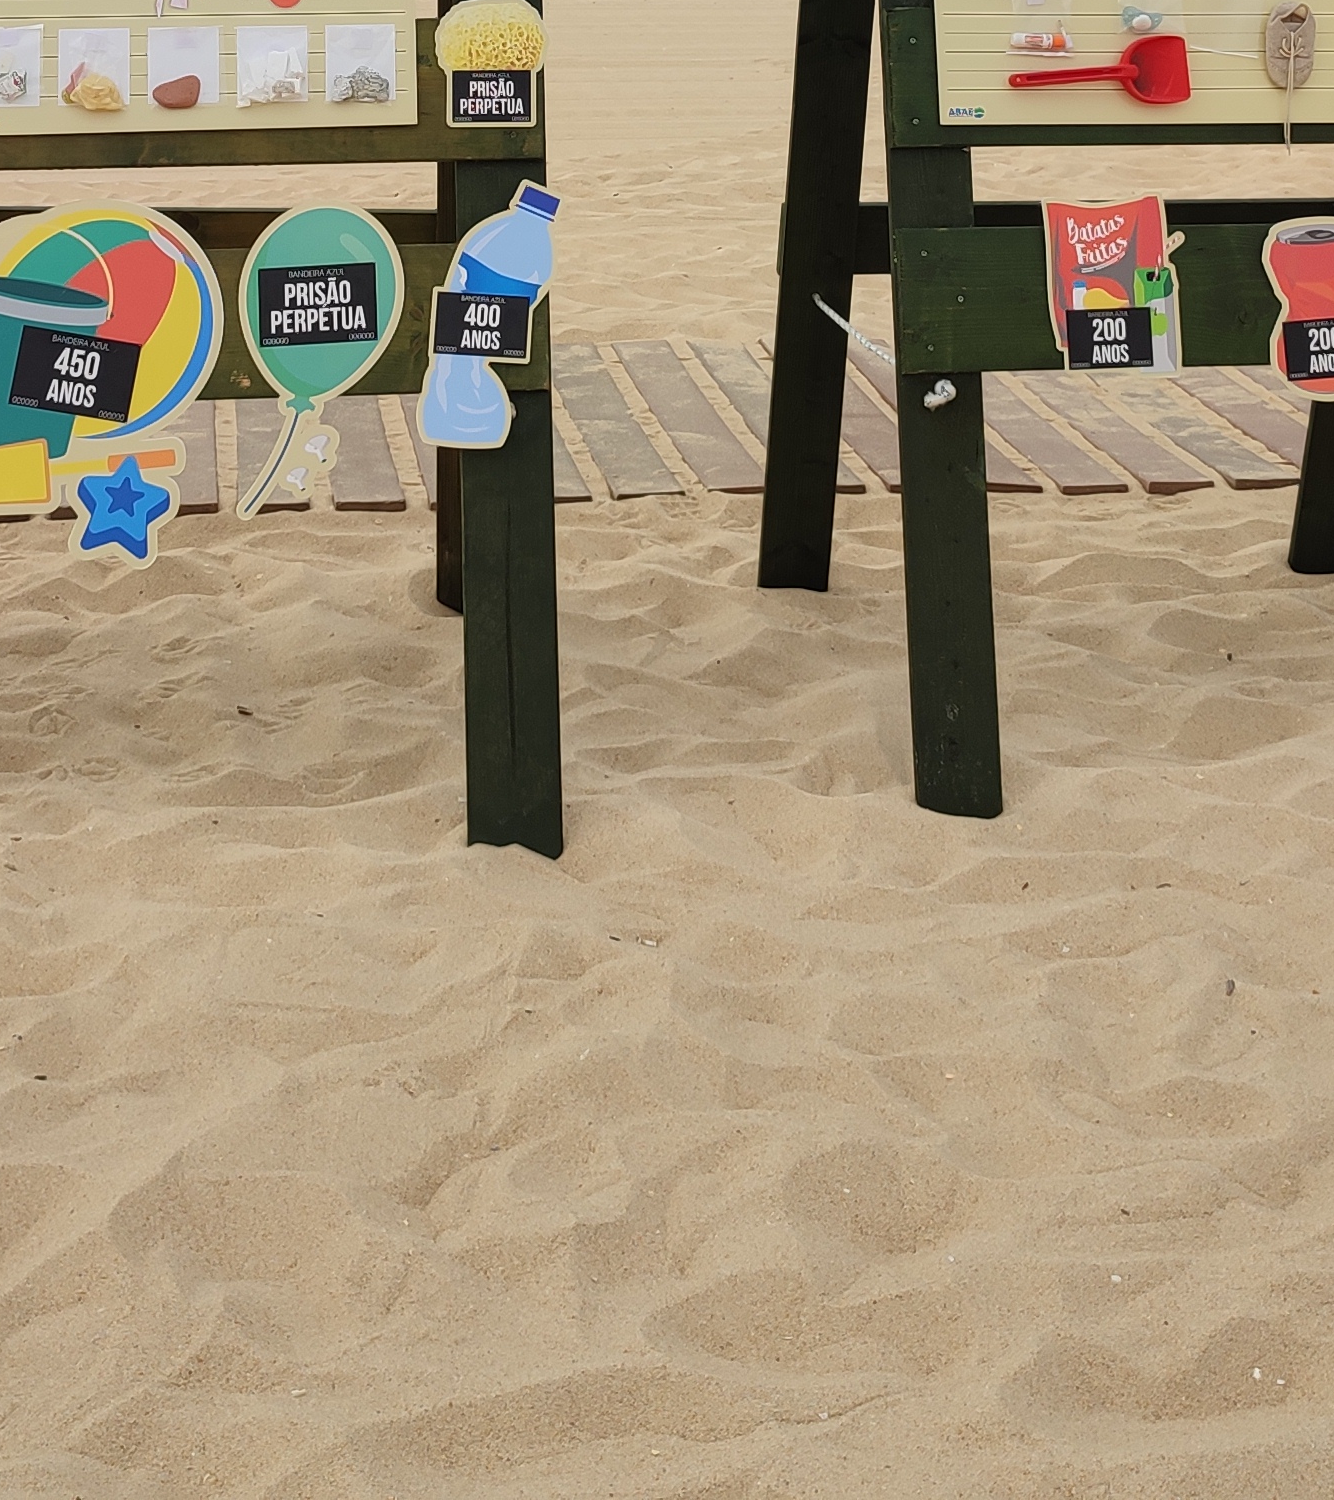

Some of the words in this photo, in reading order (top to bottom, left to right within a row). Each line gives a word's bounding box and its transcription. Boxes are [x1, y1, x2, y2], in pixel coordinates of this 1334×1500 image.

[469, 78, 515, 97] PRISÃO
[459, 96, 524, 116] PERPÉTUA
[948, 107, 973, 117] ABAE
[1067, 214, 1125, 245] Batatas
[1075, 236, 1129, 265] Fritas
[288, 269, 324, 278] BANDEIRA
[325, 268, 345, 276] AZUL
[284, 277, 352, 307] PRISÃO
[270, 304, 367, 334] PERPÉTUA
[464, 304, 501, 327] 400
[460, 329, 502, 350] ANOS
[1092, 318, 1126, 342] 200
[51, 333, 89, 348] BANDEIRA
[89, 339, 110, 352] AZUL
[1092, 343, 1130, 364] ANOS
[54, 348, 101, 381] 450
[46, 378, 97, 408] ANOS
